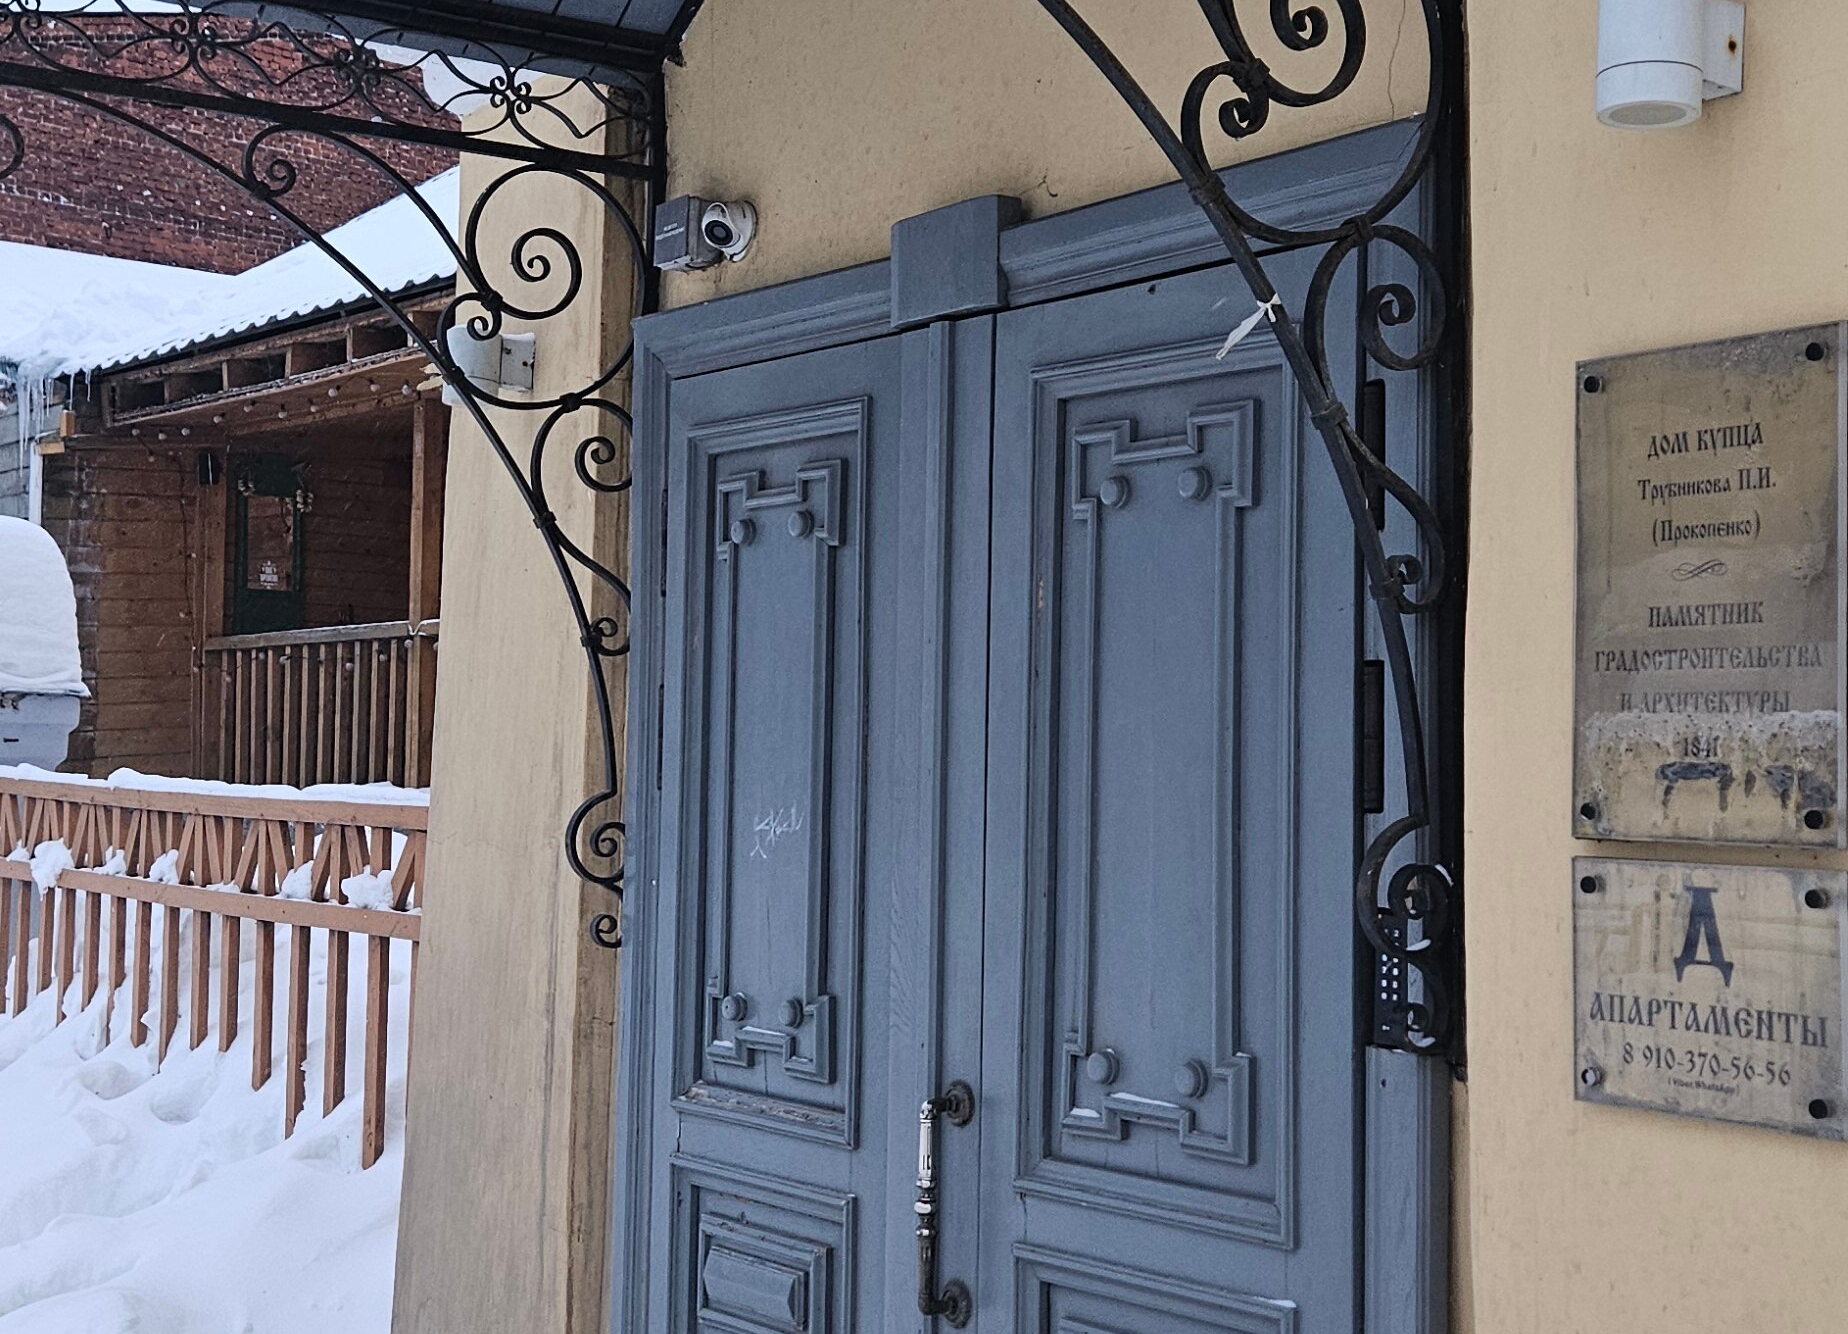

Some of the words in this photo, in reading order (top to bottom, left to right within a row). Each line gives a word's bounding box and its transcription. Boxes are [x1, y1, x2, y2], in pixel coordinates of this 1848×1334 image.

[1647, 430, 1690, 461] ДОМ
[1696, 421, 1764, 457] КУПЦА
[1637, 478, 1732, 506] Трубникова
[1739, 466, 1777, 491] П.И.
[1652, 509, 1761, 548] (Прокопенко)
[1648, 601, 1764, 629] ПАМЯТНИК
[1593, 643, 1823, 674] ГРАДОСТРОИТЕЛЬСТВА
[1620, 692, 1632, 713] И
[1642, 690, 1791, 714] АРХИТЕКТУРЫ
[1673, 886, 1735, 988] Д
[1589, 991, 1829, 1049] АПАРТАМЕНТЫ
[1622, 1041, 1634, 1065] 8
[1642, 1044, 1792, 1087] 910-370-56-56
